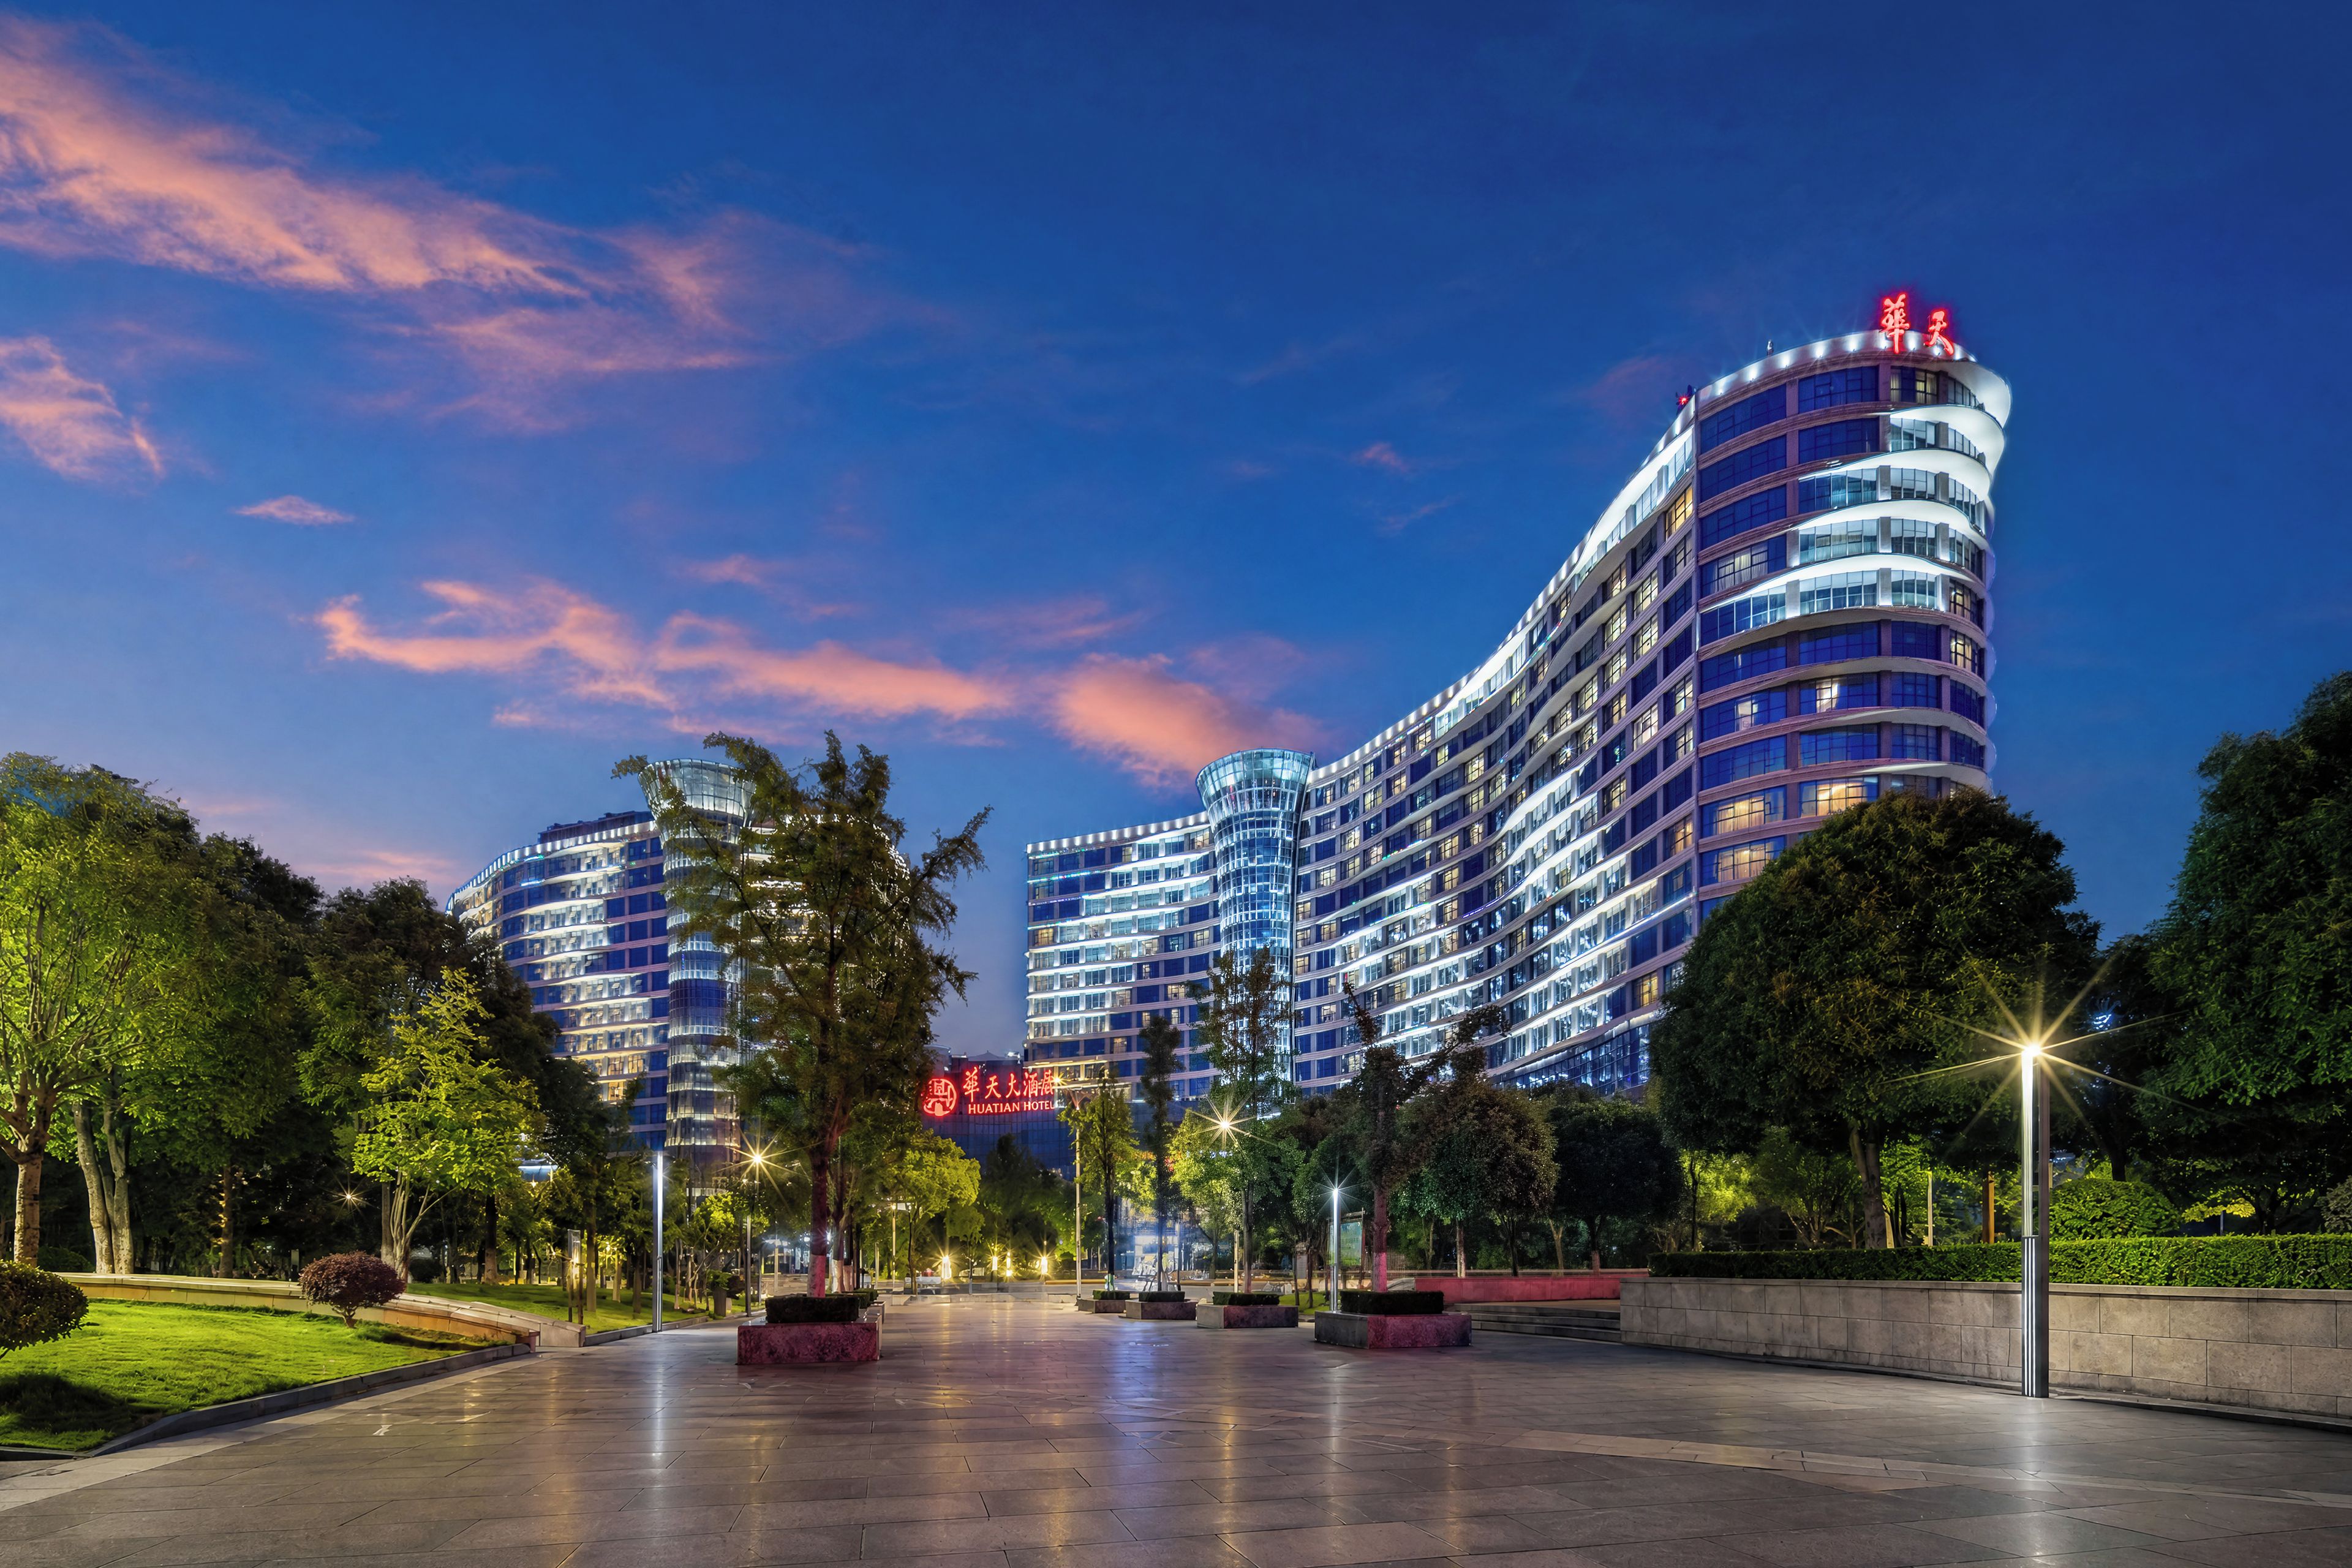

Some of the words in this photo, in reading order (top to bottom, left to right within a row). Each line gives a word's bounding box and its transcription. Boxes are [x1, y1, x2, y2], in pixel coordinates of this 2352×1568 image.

[1880, 294, 1954, 355] 華天
[968, 1102, 1020, 1114] HUATIAN
[1023, 1101, 1055, 1111] HOTEL
